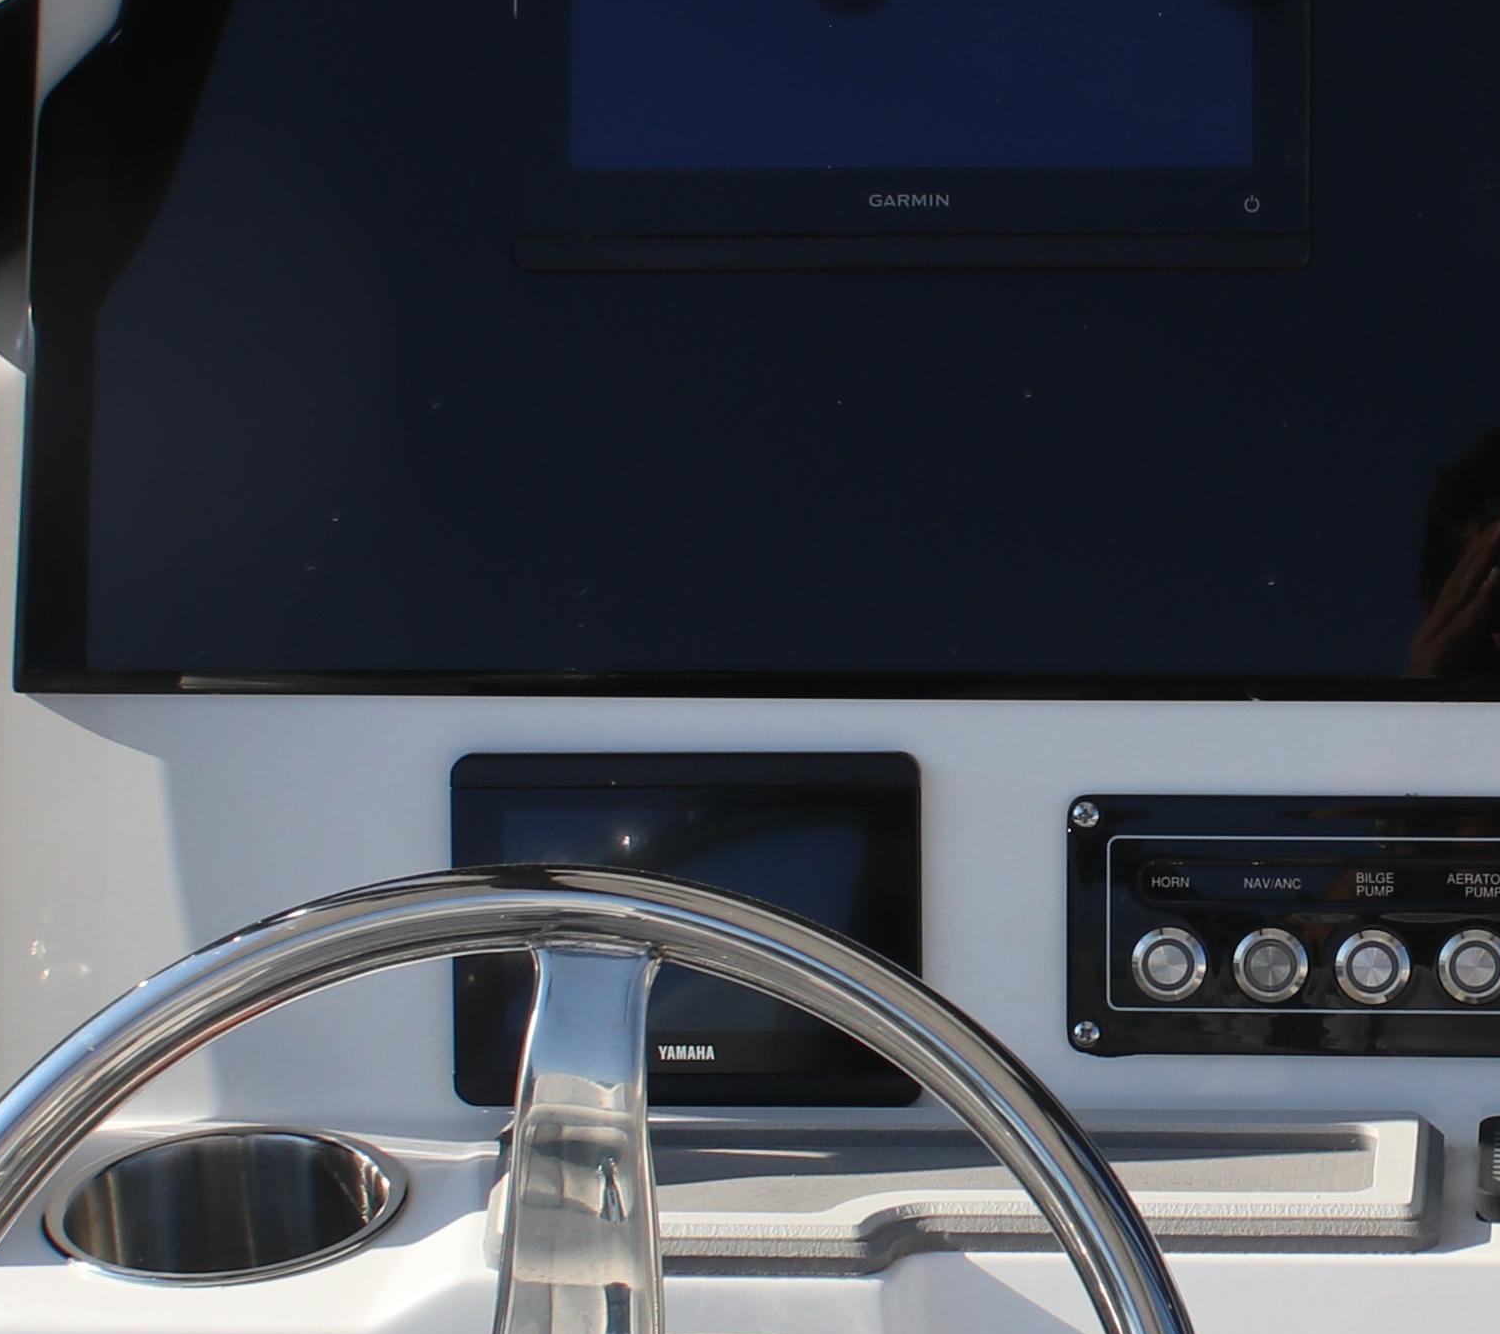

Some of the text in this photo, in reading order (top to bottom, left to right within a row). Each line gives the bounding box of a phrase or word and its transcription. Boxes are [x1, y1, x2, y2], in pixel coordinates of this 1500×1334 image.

[869, 194, 950, 207] GARMIN
[1151, 877, 1189, 888] HORN
[1243, 878, 1301, 889] NAV/ANC
[1356, 873, 1393, 884] BILGE
[1356, 885, 1393, 897] PUMP
[658, 1045, 715, 1060] YAMAHA
